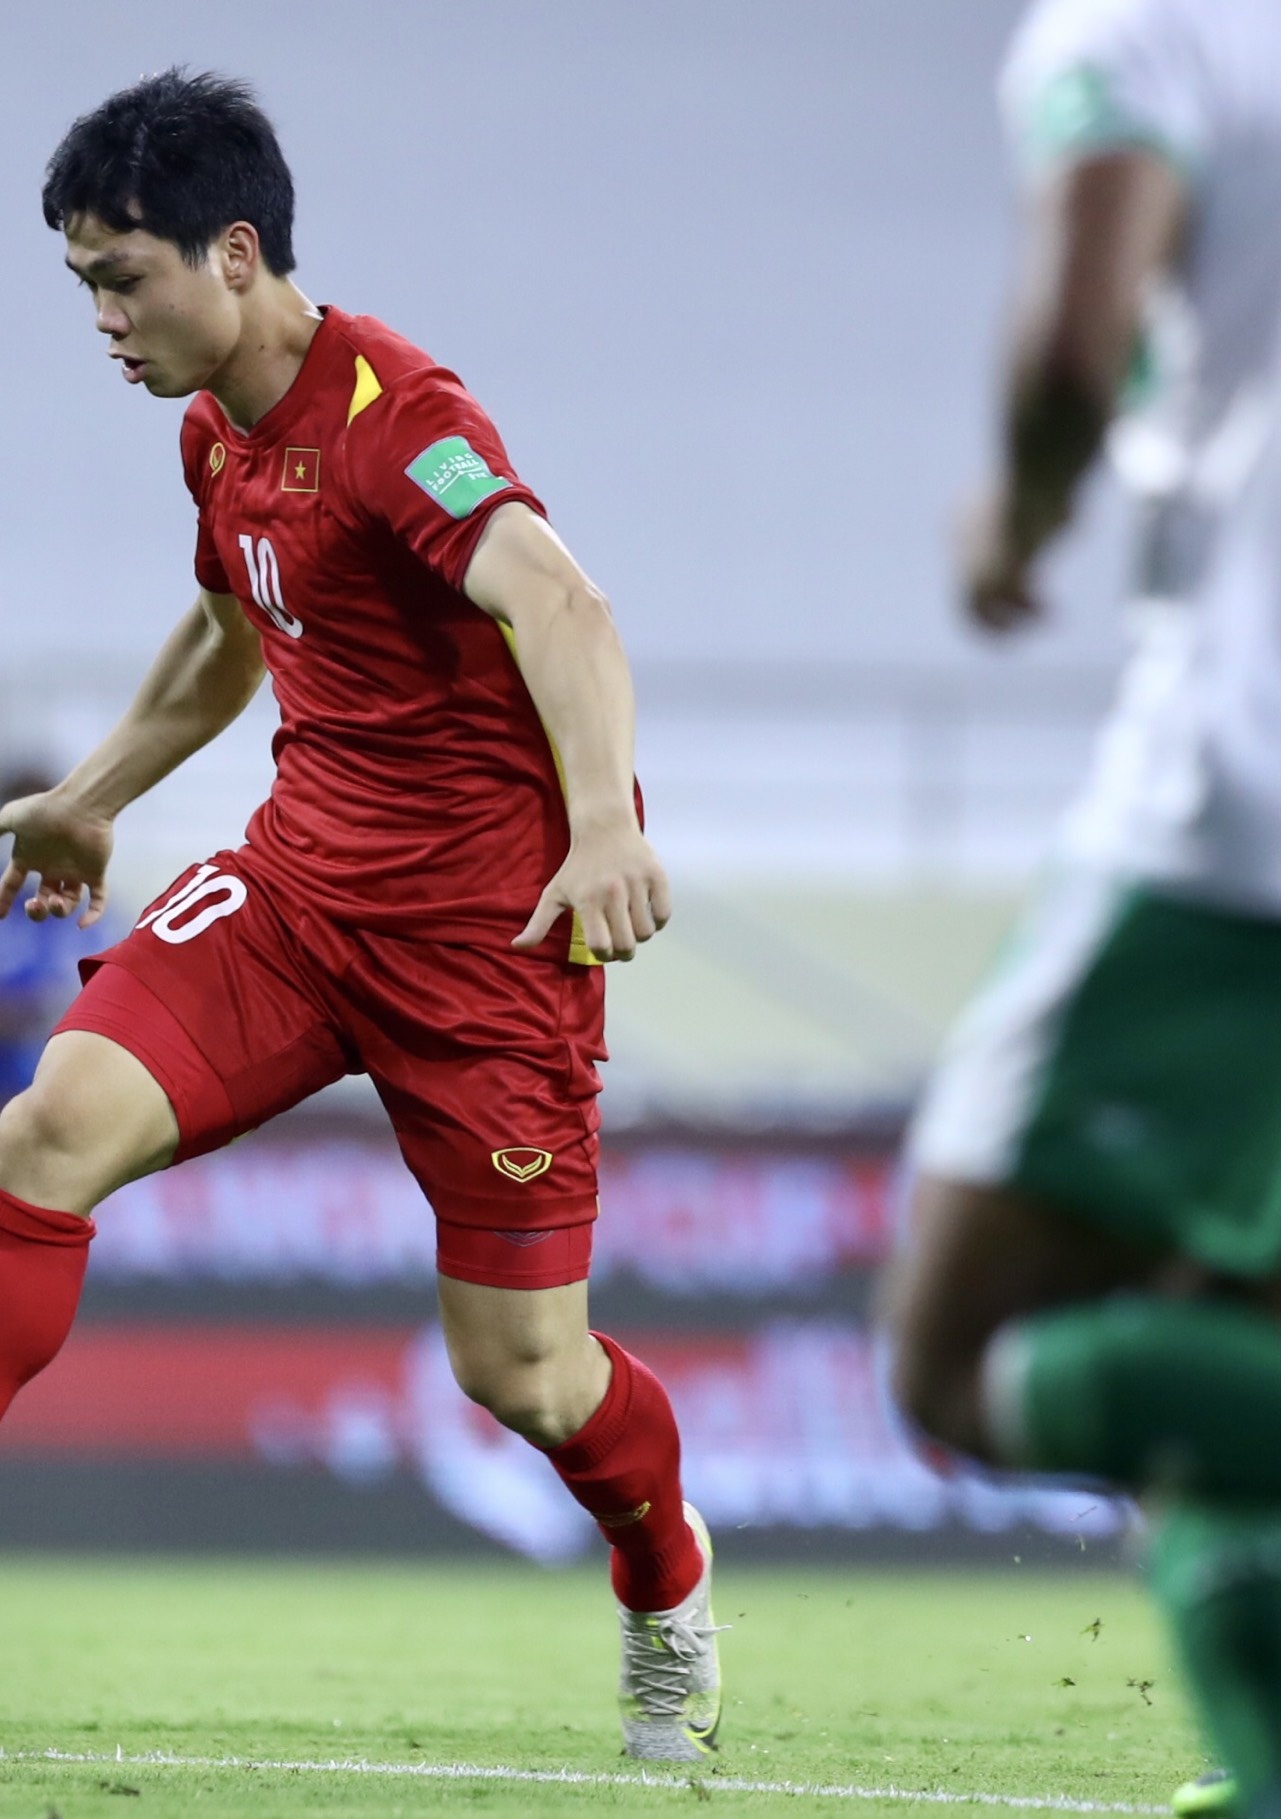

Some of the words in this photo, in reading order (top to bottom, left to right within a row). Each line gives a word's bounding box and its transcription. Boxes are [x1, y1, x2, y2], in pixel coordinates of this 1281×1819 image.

[426, 453, 473, 485] LIVING
[432, 459, 479, 491] FOOTBALL
[239, 534, 304, 639] 10
[135, 864, 247, 944] 10
